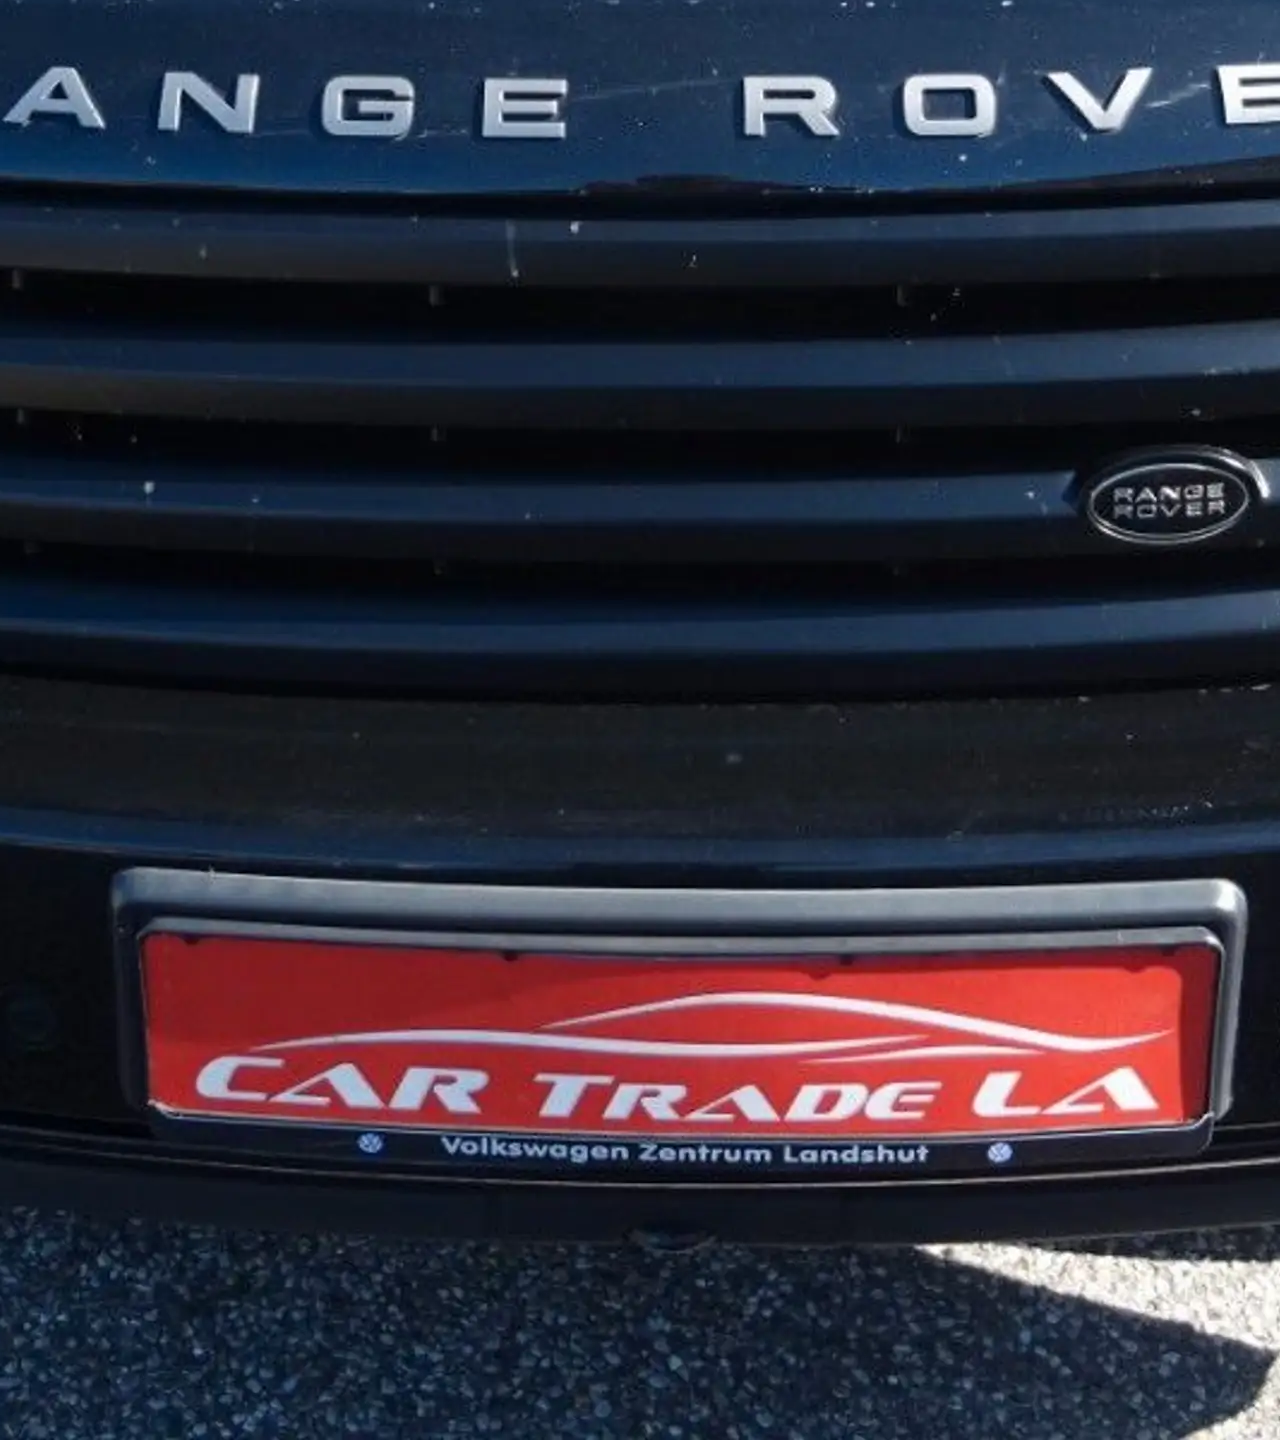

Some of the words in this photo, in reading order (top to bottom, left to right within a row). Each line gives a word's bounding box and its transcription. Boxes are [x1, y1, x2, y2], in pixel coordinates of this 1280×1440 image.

[1113, 482, 1225, 503] RANGE
[1113, 499, 1225, 519] ROVER
[195, 1055, 490, 1114] CAR
[532, 1072, 943, 1122] TRADE
[972, 1066, 1160, 1118] LA
[441, 1135, 629, 1163] Volkswagen
[639, 1142, 772, 1163] Zentrum
[783, 1144, 929, 1164] Landshut
